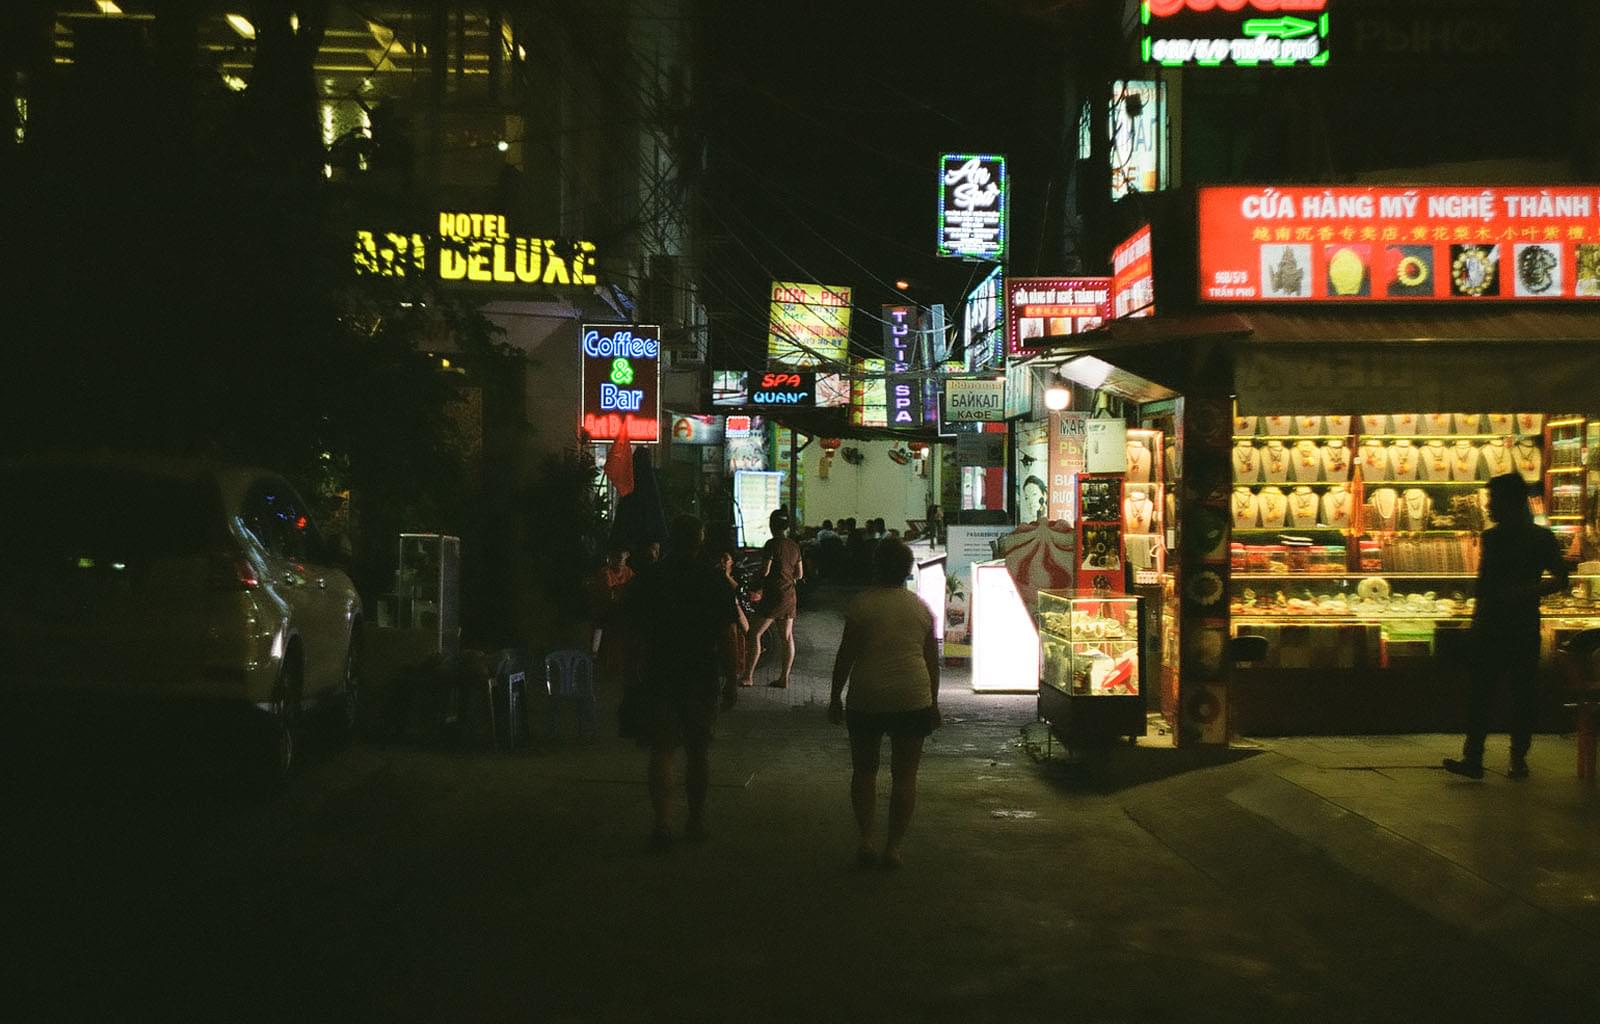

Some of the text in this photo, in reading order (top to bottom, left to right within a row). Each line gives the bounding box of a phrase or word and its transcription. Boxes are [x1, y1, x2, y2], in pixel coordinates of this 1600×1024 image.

[1242, 187, 1591, 222] CỬA HÀNG MỸ NGHỆ THÀNH
[439, 212, 510, 239] HOTEL
[584, 330, 659, 358] Coffee
[610, 357, 635, 385] &
[761, 372, 801, 389] SPA
[600, 383, 644, 411] Bar
[895, 384, 913, 423] SPA
[951, 390, 999, 409] БАЙКАЛ
[957, 410, 992, 420] КАФЕ
[1060, 418, 1086, 434] MAR
